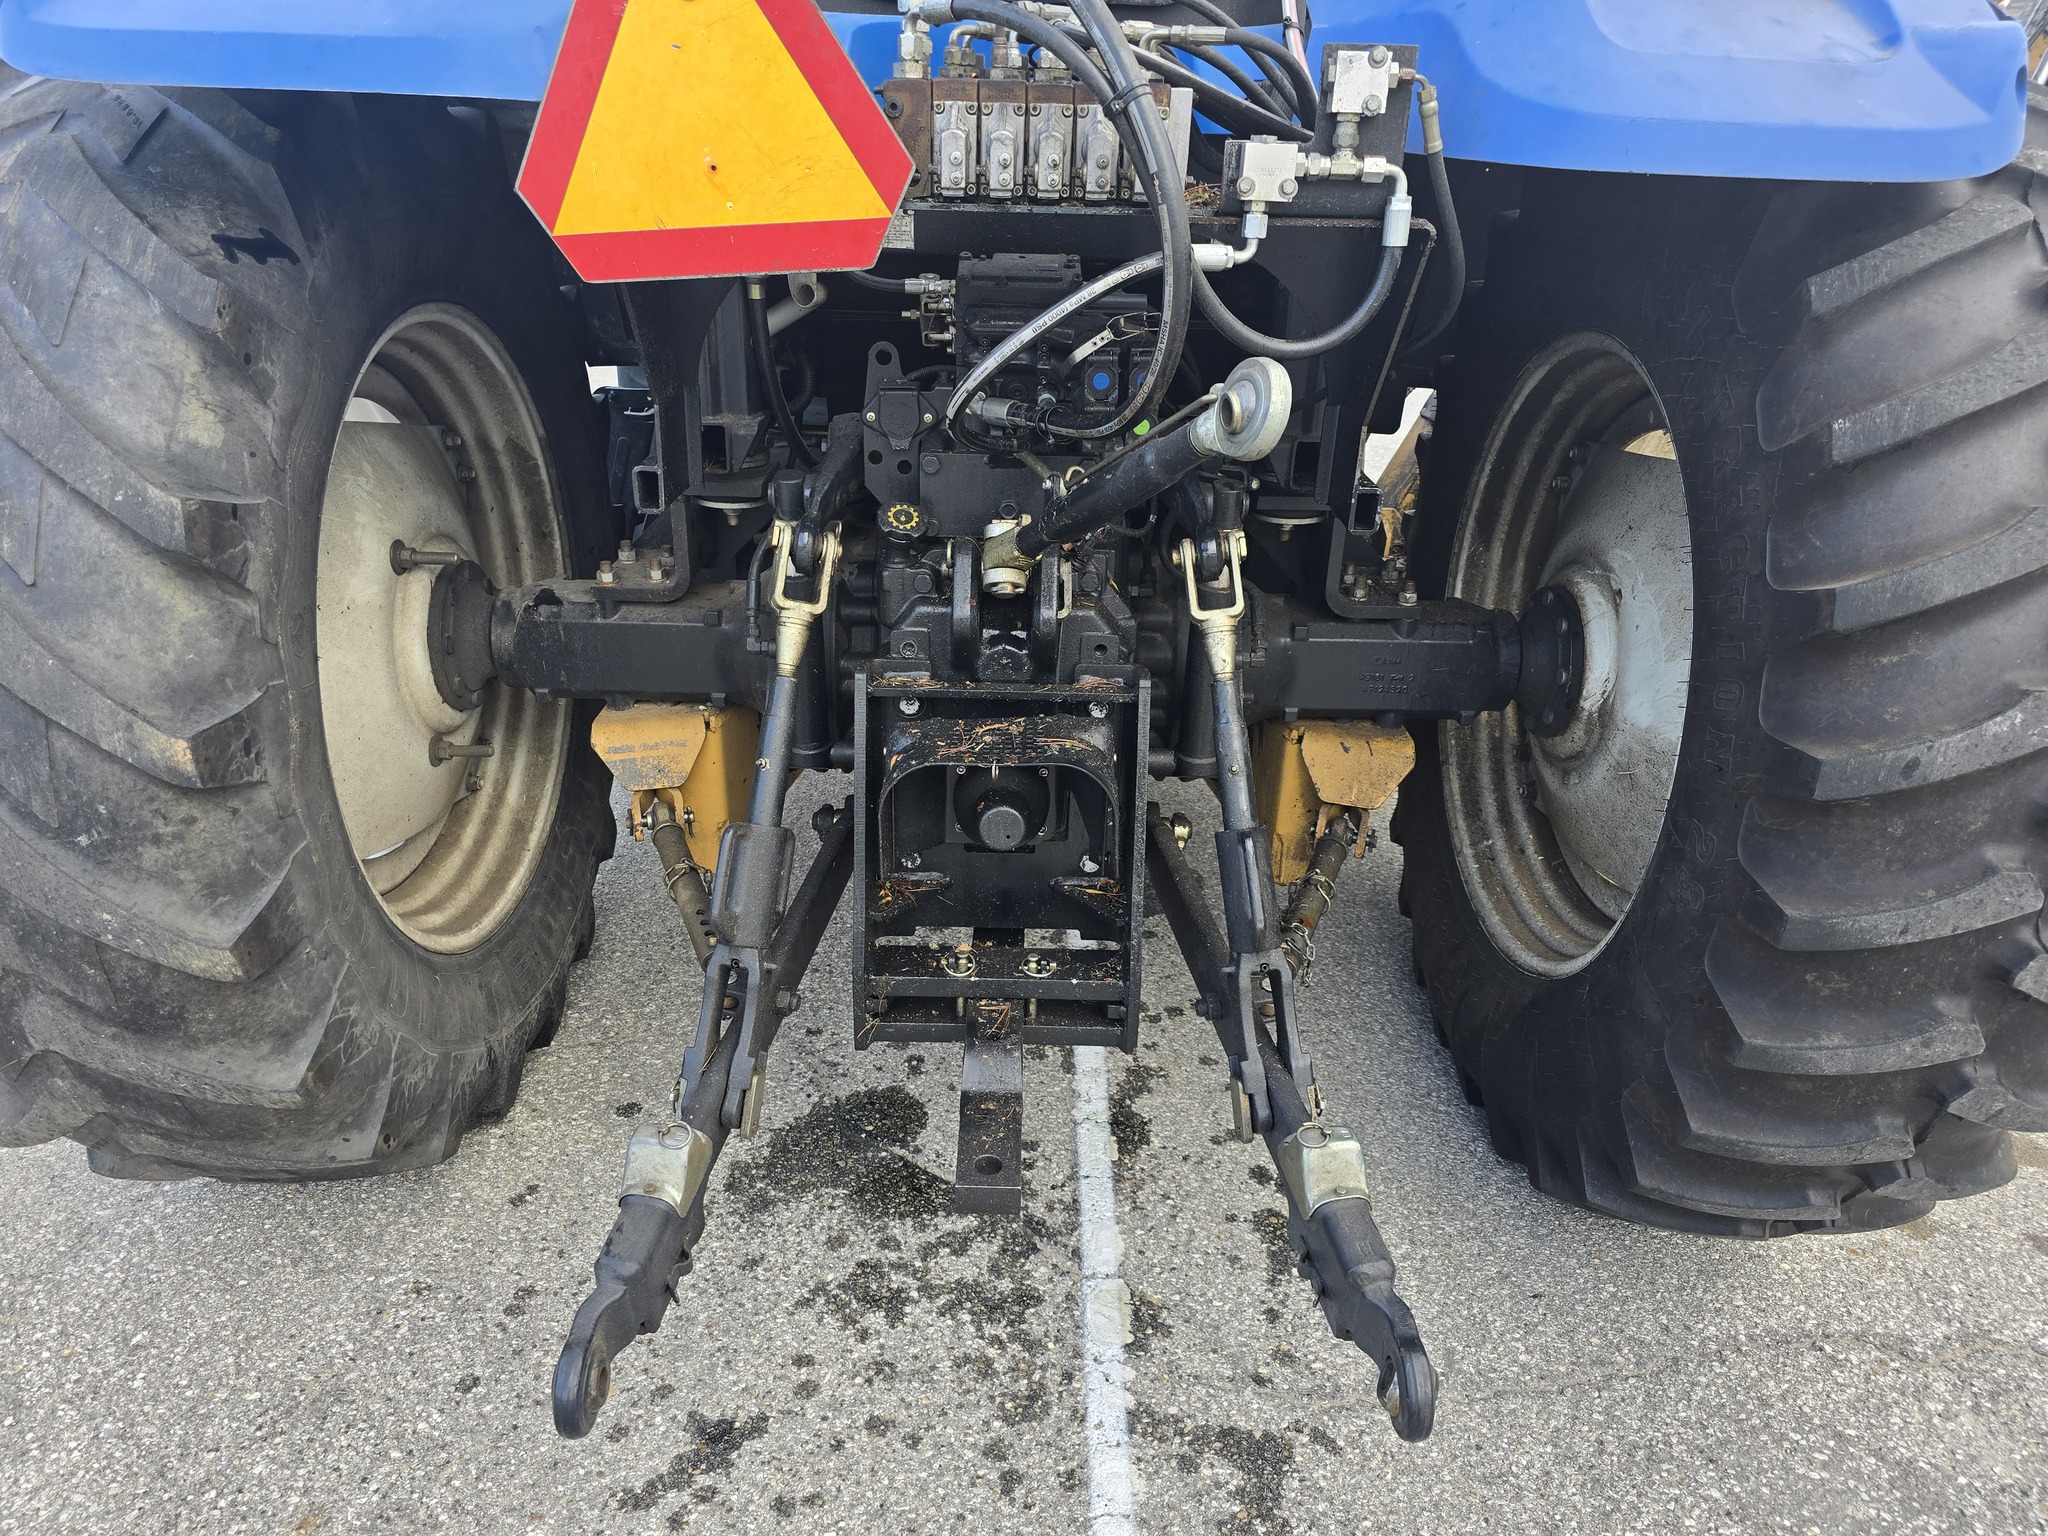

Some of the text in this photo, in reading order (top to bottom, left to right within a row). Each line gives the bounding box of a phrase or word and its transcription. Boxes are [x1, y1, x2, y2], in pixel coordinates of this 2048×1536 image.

[1086, 287, 1097, 297] 28
[1068, 293, 1086, 308] MPa
[1047, 305, 1068, 323] (4000
[1031, 319, 1048, 334] PSI)
[1150, 320, 1169, 378] MSHA IC-40/26
